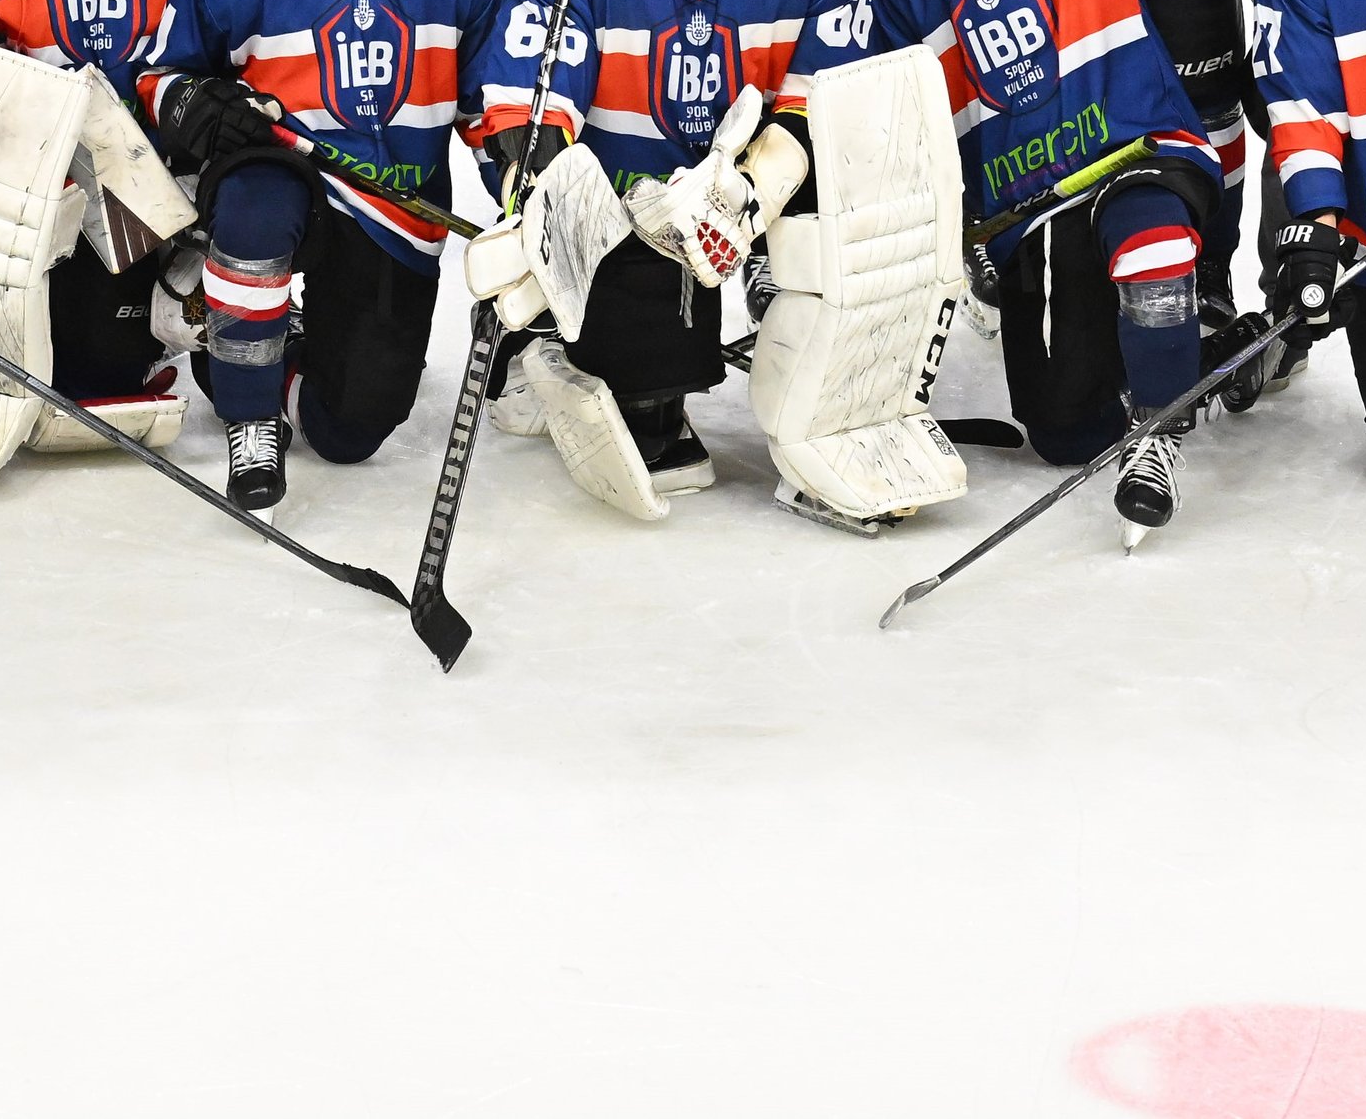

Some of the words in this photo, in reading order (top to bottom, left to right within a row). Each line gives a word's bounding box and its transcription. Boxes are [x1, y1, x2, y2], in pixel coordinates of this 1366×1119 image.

[1004, 59, 1032, 78] SPOR
[1174, 49, 1234, 78] AUER
[983, 97, 1112, 201] Intercity
[914, 296, 957, 407] CCM
[419, 339, 491, 586] WARRIOR
